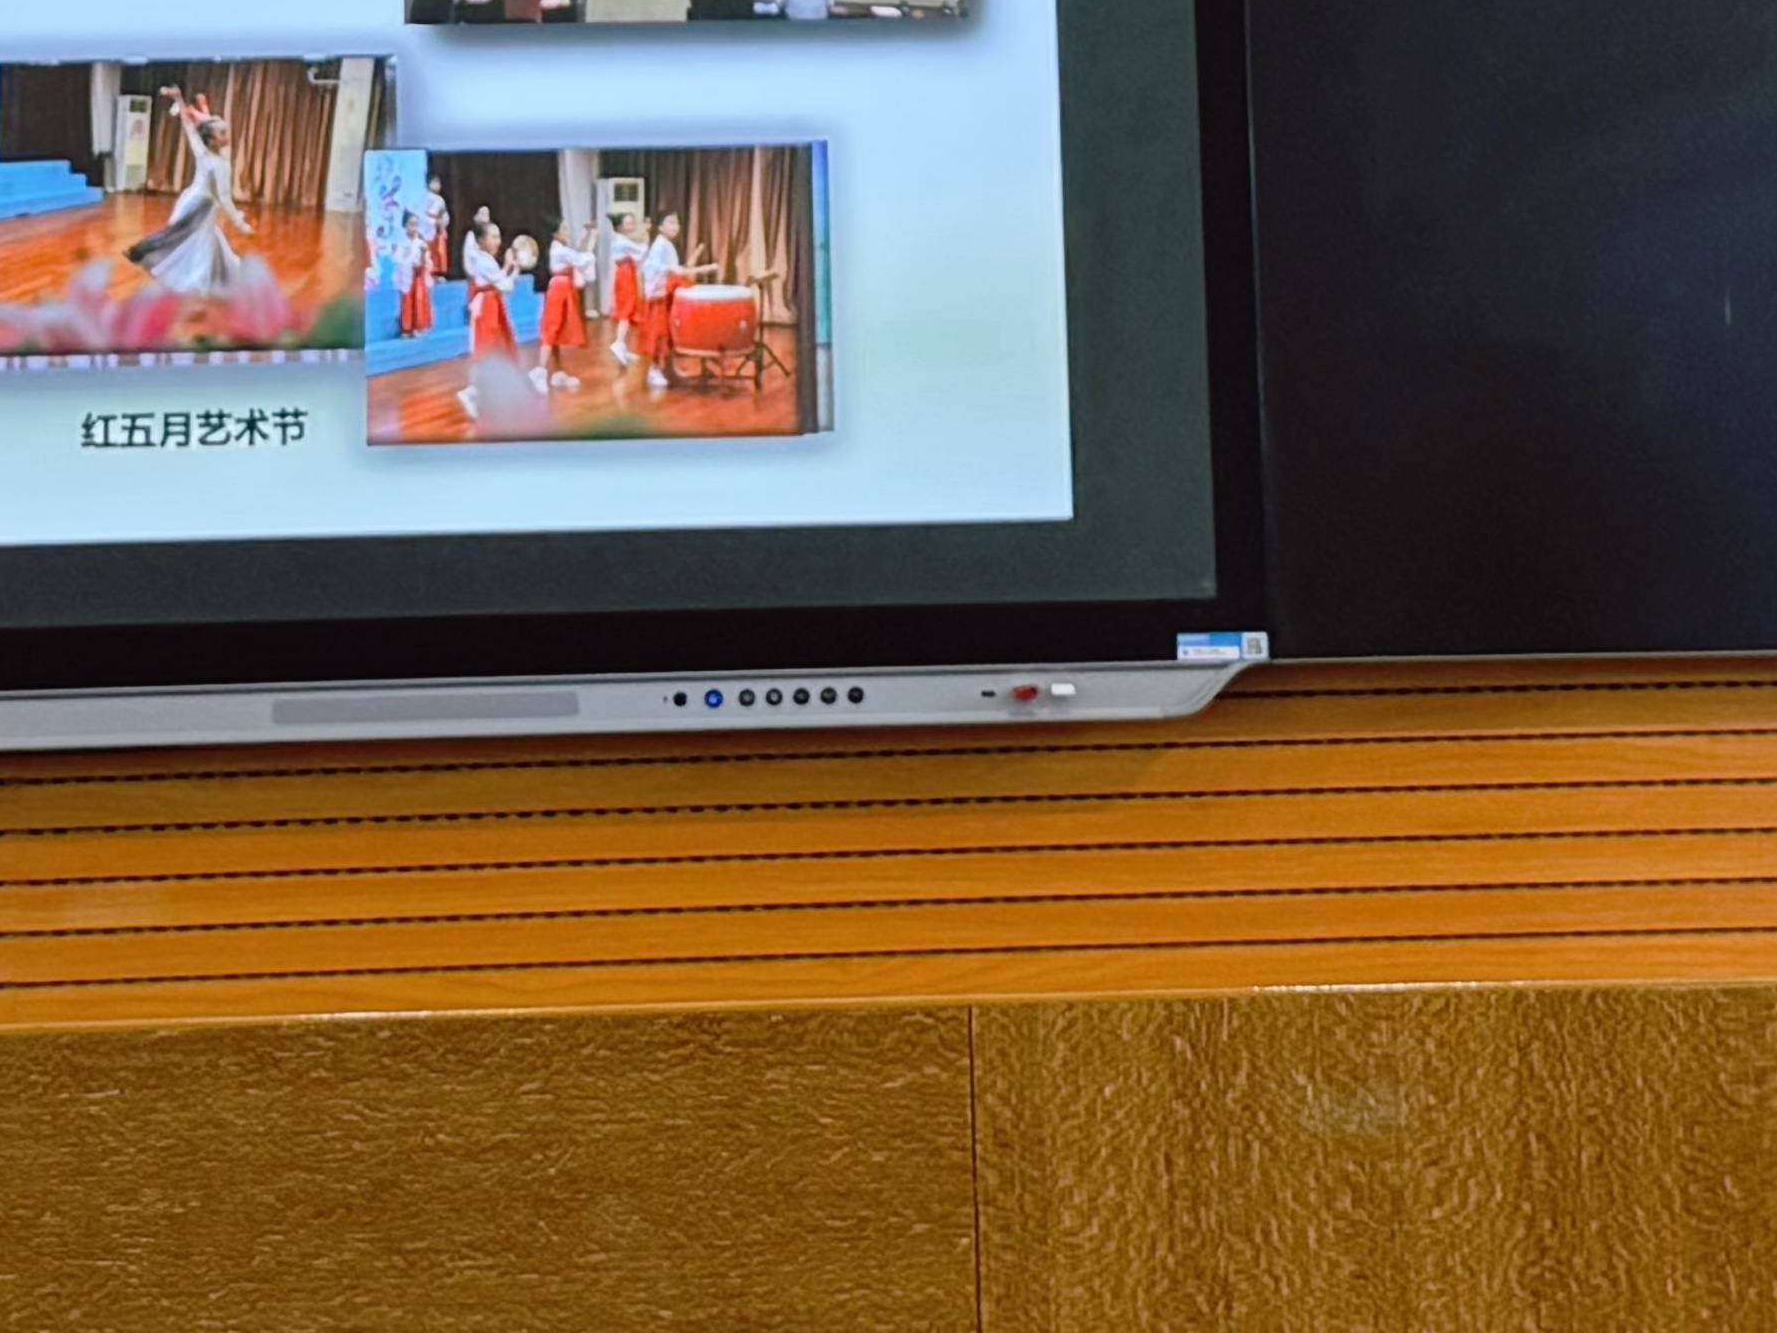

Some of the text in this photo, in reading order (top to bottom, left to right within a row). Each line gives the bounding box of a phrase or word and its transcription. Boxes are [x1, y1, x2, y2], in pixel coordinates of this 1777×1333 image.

[80, 406, 309, 448] 红五月艺术节
